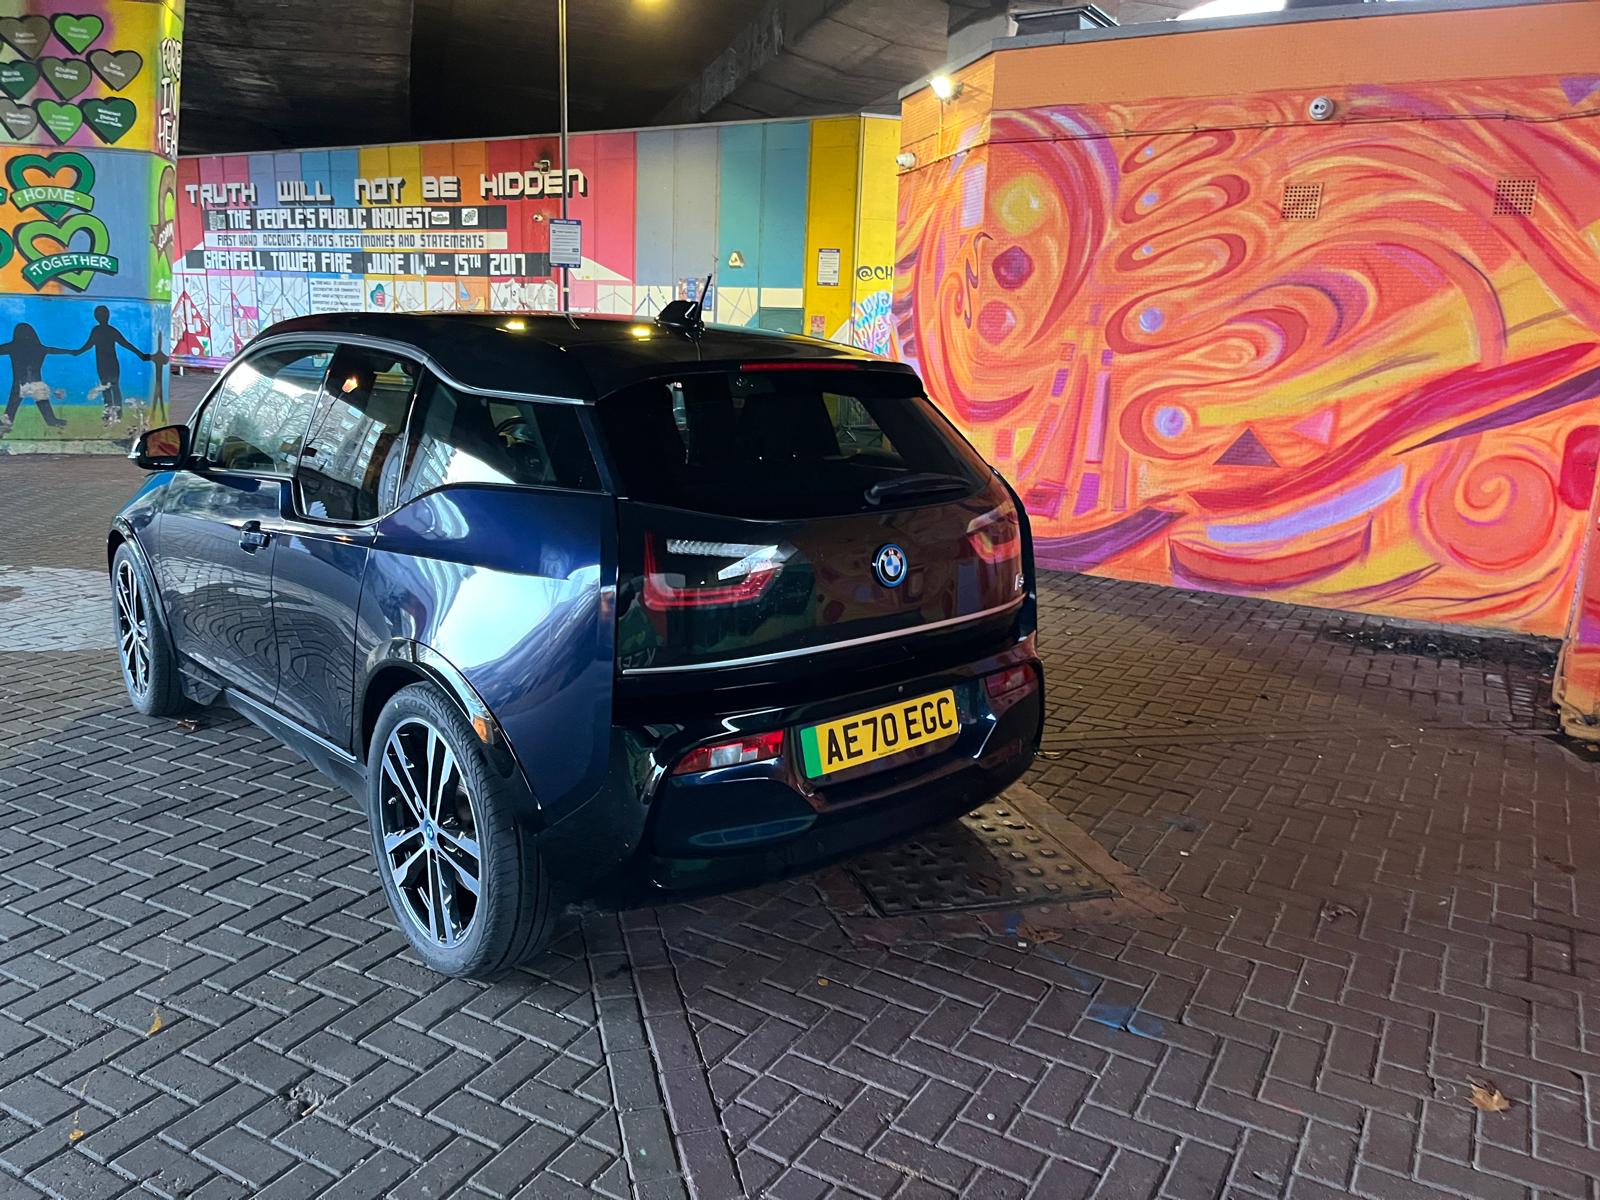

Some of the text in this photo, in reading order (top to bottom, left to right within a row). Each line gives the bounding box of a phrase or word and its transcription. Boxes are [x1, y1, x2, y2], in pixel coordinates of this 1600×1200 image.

[22, 188, 75, 203] HOME
[185, 182, 257, 206] TRUTH
[277, 180, 333, 203] WILL
[422, 176, 460, 200] BE
[226, 209, 251, 229] THE
[256, 208, 316, 229] PEOPLE'S
[319, 208, 367, 229] PUBLIC
[371, 207, 432, 229] INQUEST
[217, 234, 236, 247] FIRST
[340, 234, 396, 248] TESTIMONIES
[399, 235, 416, 247] AND
[420, 234, 484, 248] STATEMENTS
[30, 255, 111, 275] TOGETHER
[203, 251, 266, 270] GRENFELL
[270, 252, 317, 272] TOWER
[321, 252, 353, 273] FIRE
[367, 253, 405, 275] JUNE
[454, 253, 482, 276] 15TH
[489, 253, 526, 276] 2017
[826, 696, 954, 766] AE70 EGC
